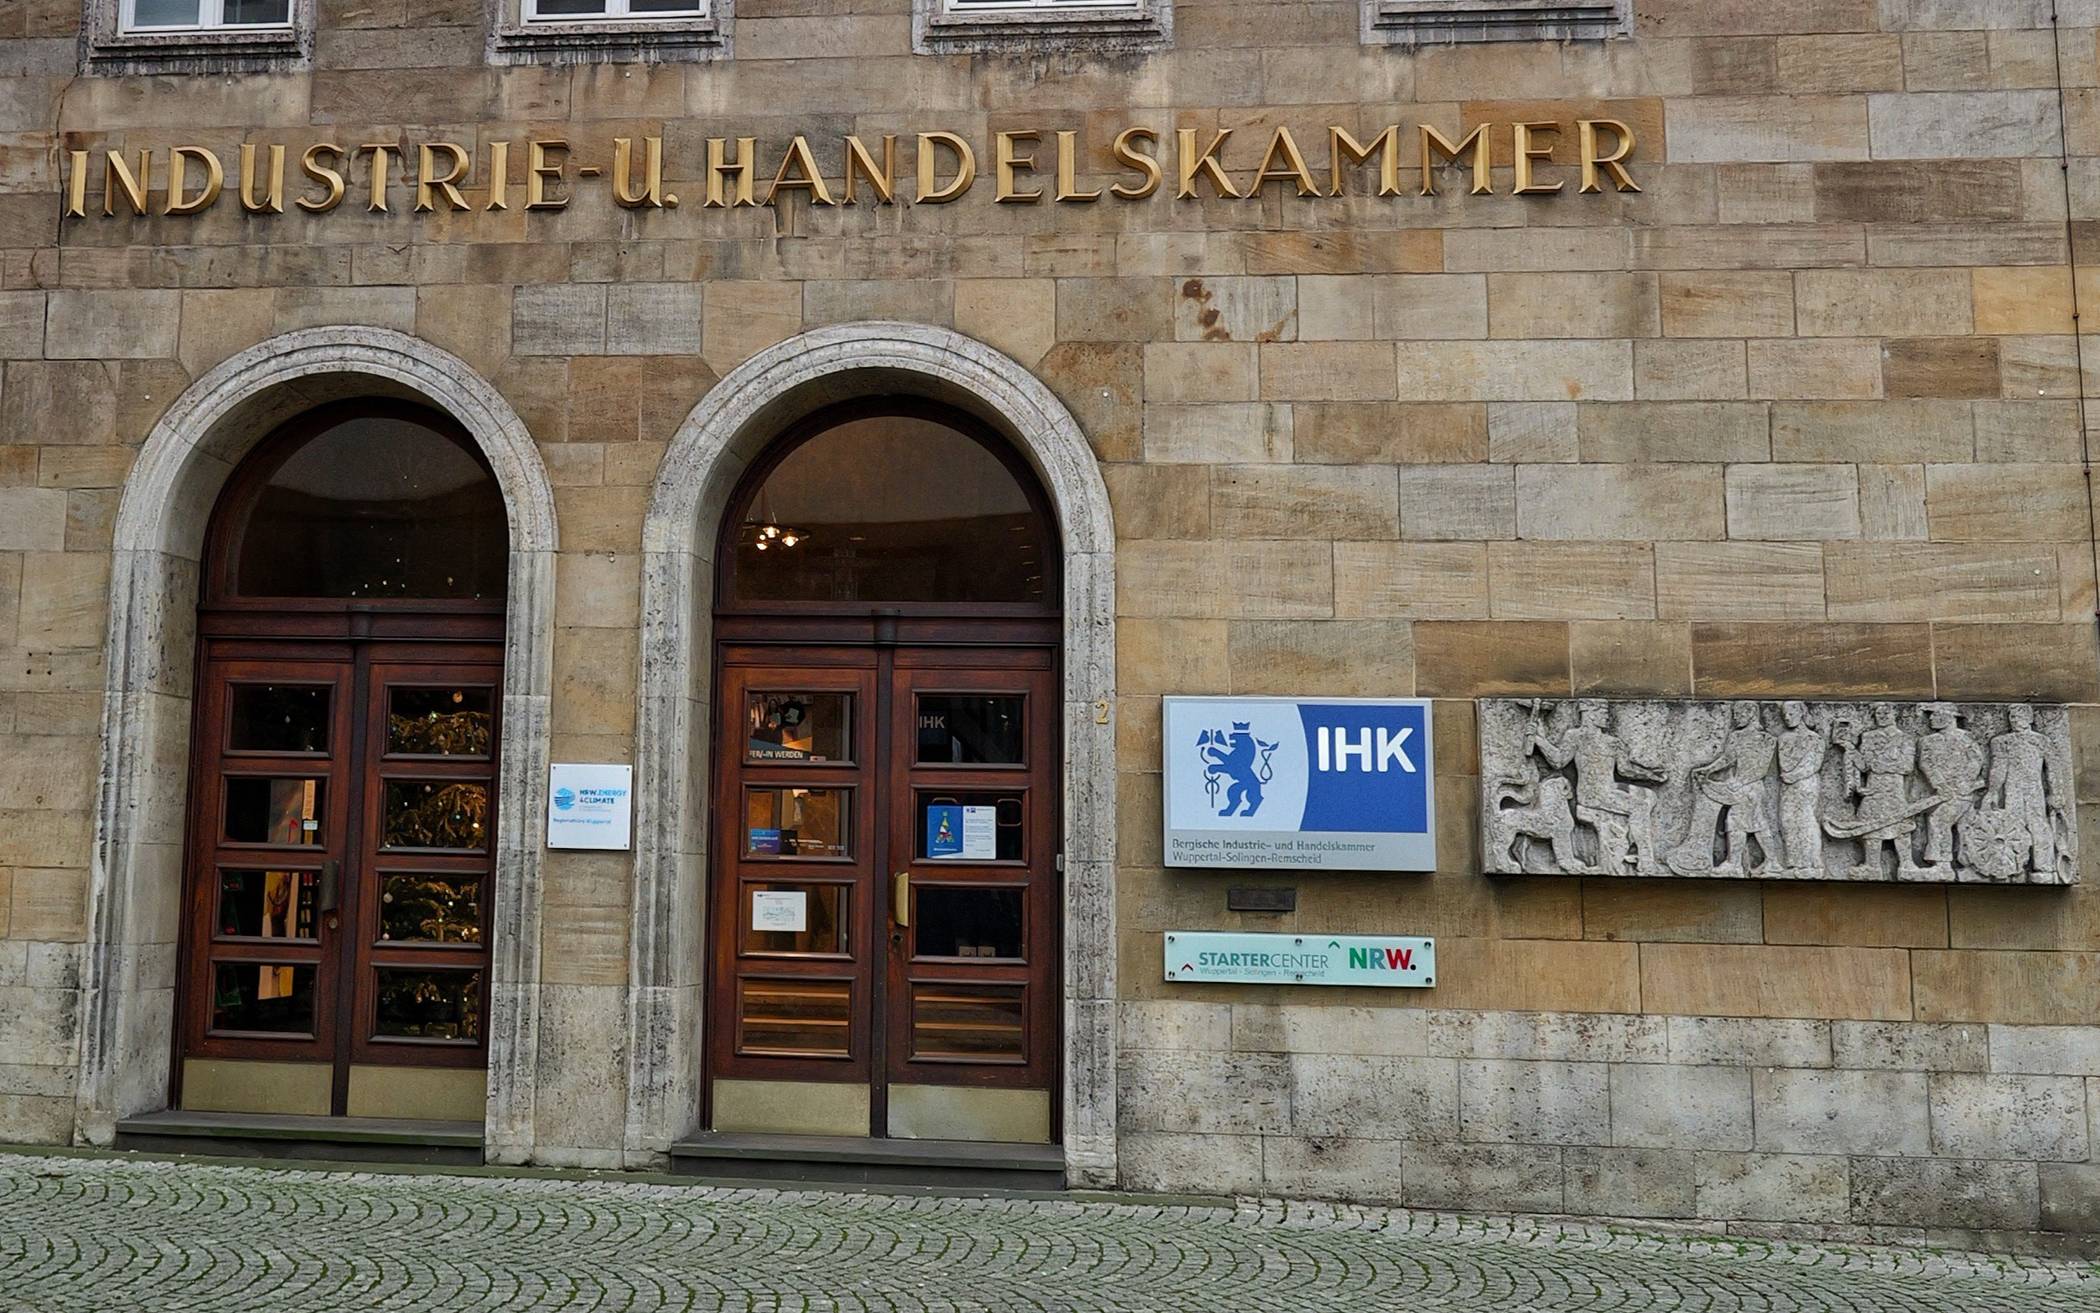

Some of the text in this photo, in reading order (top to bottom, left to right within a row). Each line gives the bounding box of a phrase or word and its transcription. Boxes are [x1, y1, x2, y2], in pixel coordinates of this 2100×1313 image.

[704, 117, 1641, 207] HANDELSKAMMER
[1095, 699, 1109, 725] 2
[919, 715, 945, 729] IHK
[774, 750, 804, 760] WERDEN
[1317, 726, 1417, 773] IHK
[1172, 838, 1376, 852] Bergische Industrie- und Handelskammer
[1173, 851, 1322, 865] Wuppertal-Solingen-Remscheid
[1199, 952, 1329, 969] STARTERCENTER
